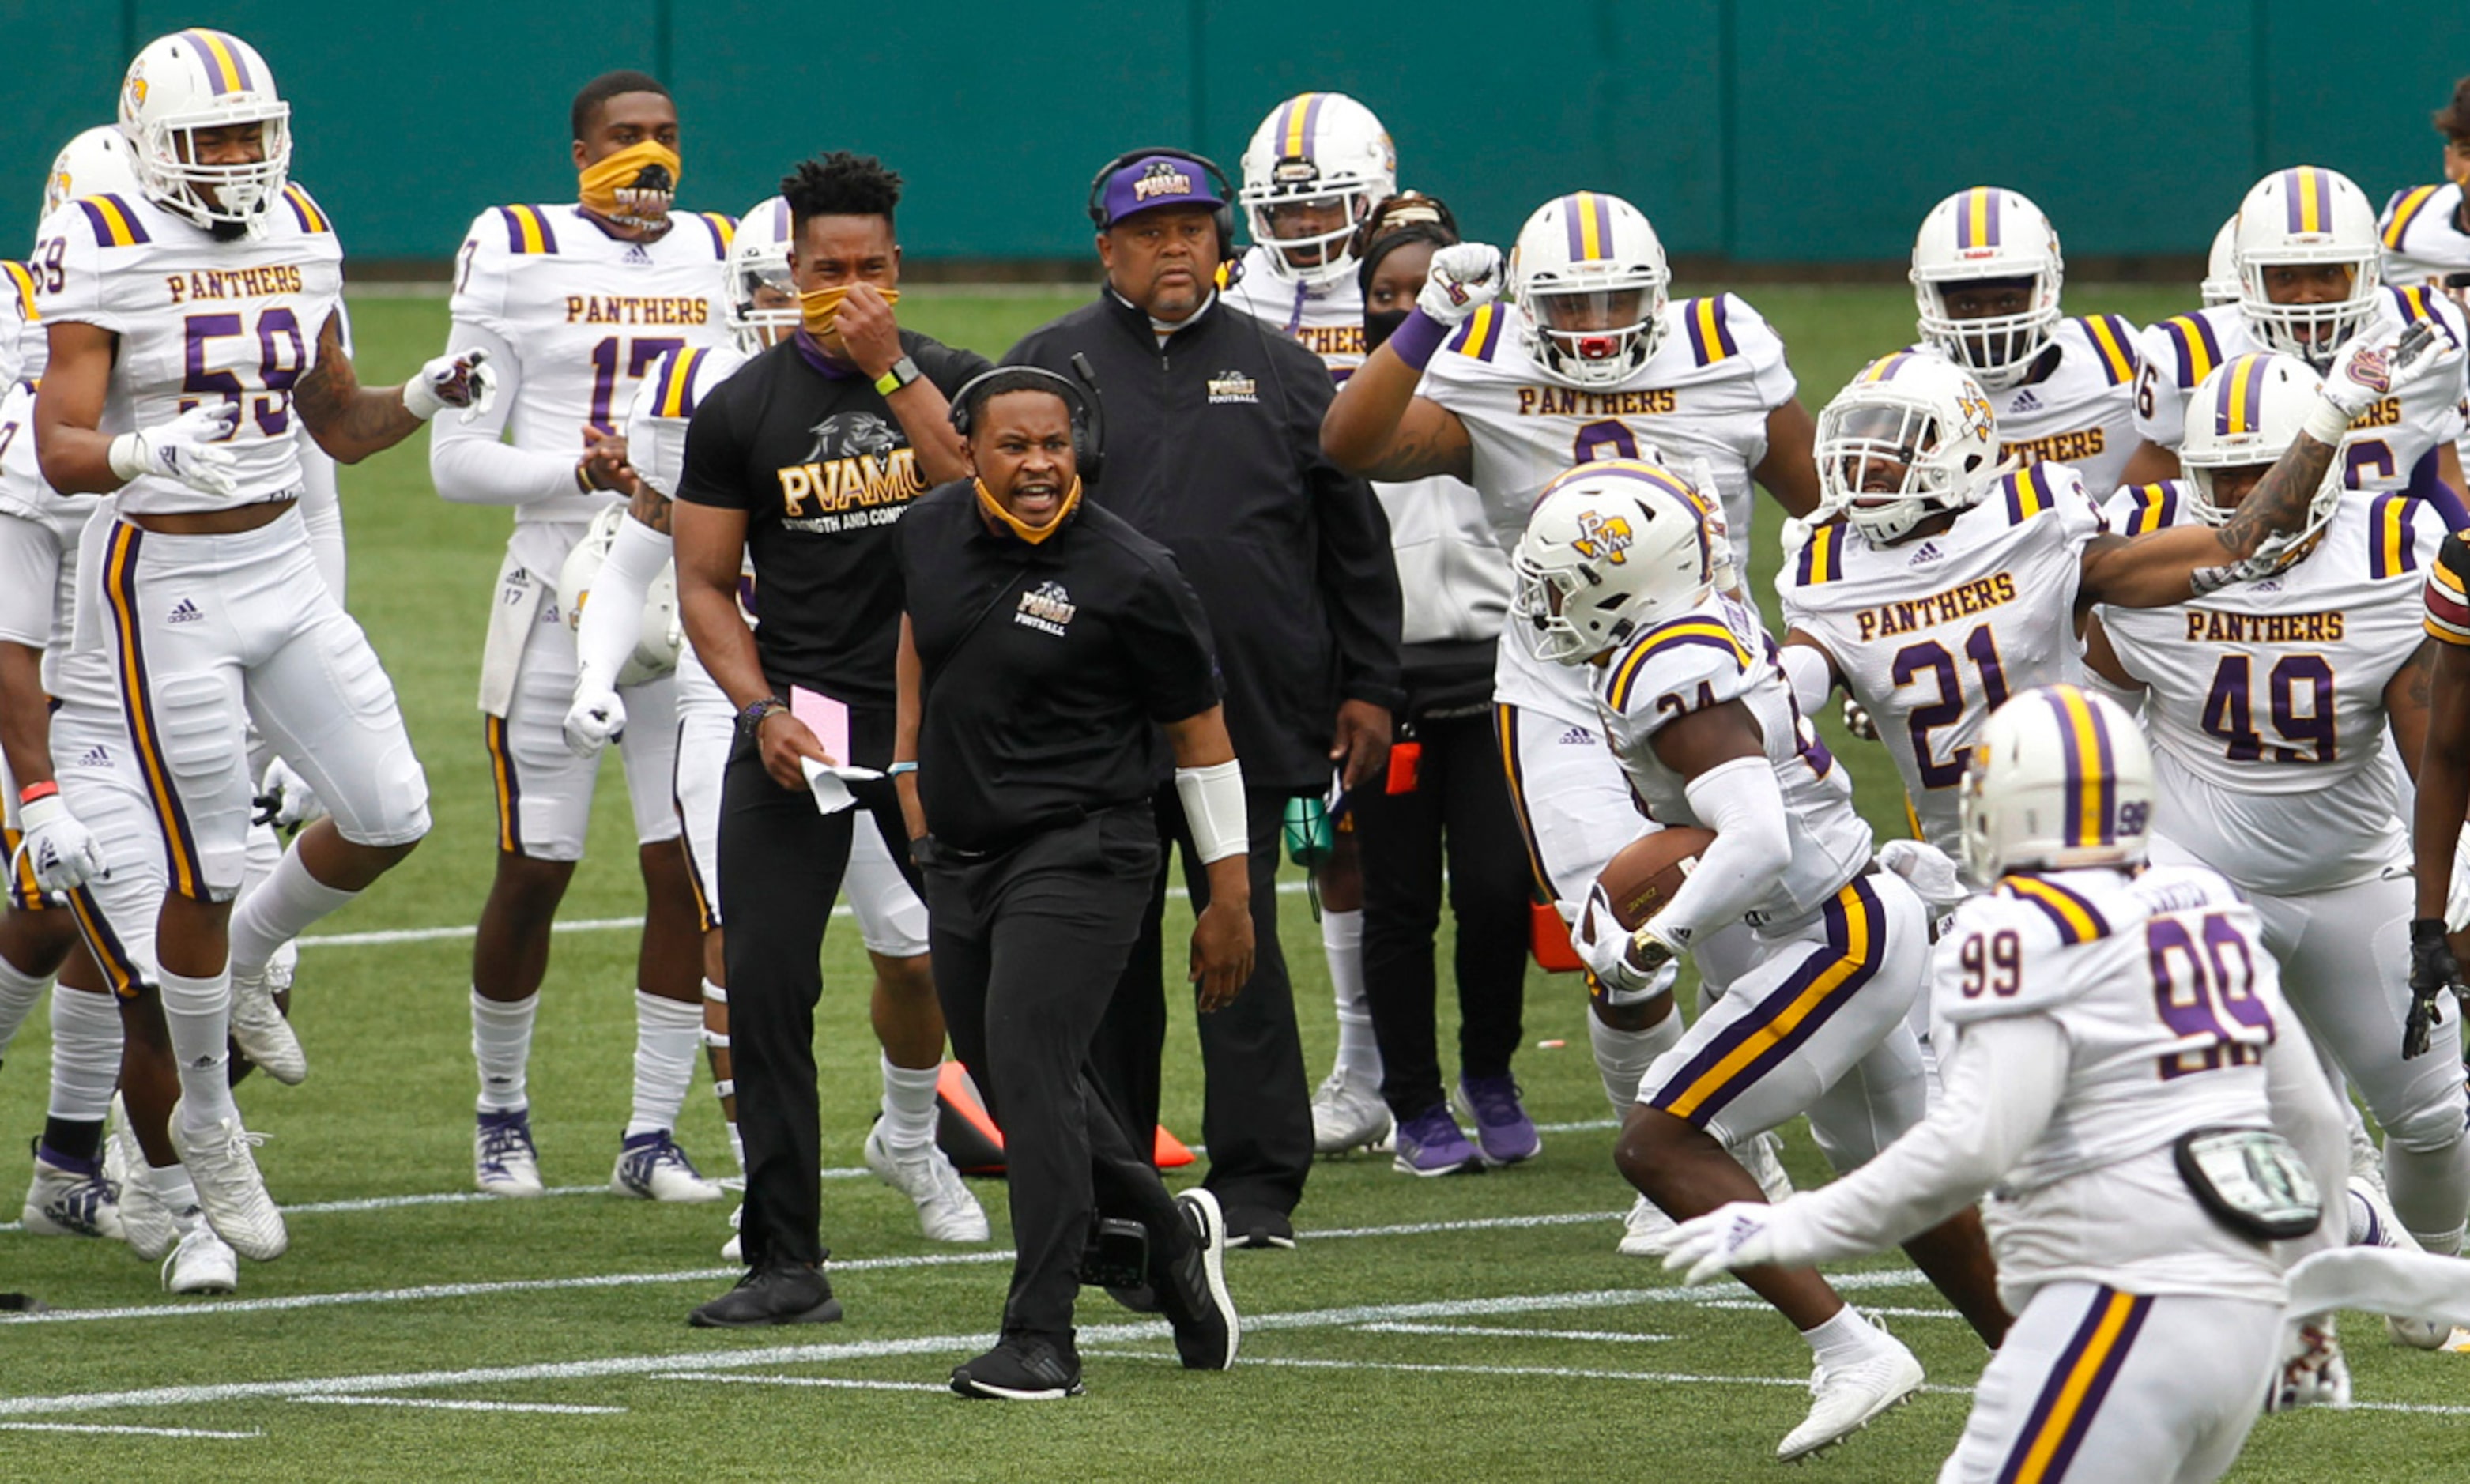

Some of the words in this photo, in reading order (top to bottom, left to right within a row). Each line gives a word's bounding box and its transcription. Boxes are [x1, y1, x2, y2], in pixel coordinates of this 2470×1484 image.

[31, 236, 66, 295] 59
[166, 265, 304, 303] PANTHERS
[564, 295, 708, 326] PANTHERS
[1297, 326, 1366, 354] THER
[179, 307, 307, 444] 59
[1517, 385, 1677, 416] PANTHERS
[776, 446, 930, 517] PVAMU
[842, 510, 869, 531] AND
[167, 612, 204, 624] adidas
[503, 587, 523, 606] 17
[1856, 571, 2017, 642] PANTHERS
[2185, 609, 2345, 642] PANTHERS
[1891, 623, 2011, 789] 21
[2200, 651, 2338, 764] 49
[1960, 928, 2022, 999] 99
[2145, 910, 2277, 1082] 99
